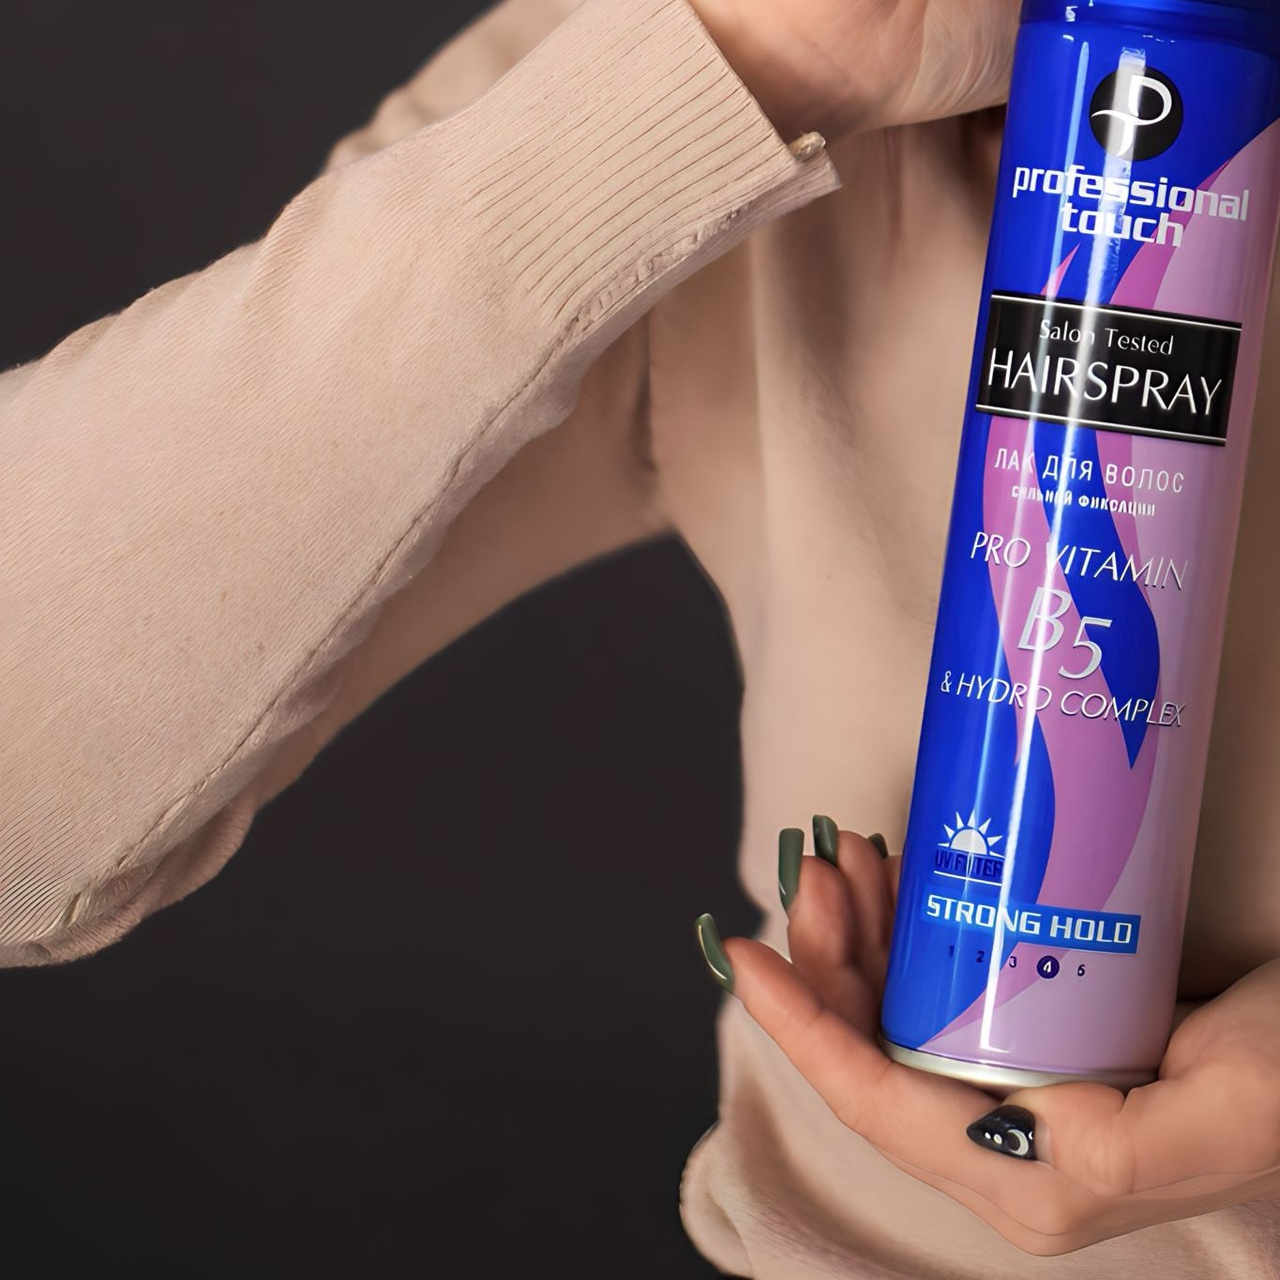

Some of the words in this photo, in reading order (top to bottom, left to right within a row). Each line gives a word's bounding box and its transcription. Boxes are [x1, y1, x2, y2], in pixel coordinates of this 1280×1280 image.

[1013, 165, 1249, 221] professional
[1061, 202, 1184, 247] touch
[1039, 319, 1096, 347] Salon
[1104, 327, 1174, 356] Tested
[987, 347, 1223, 416] HAIRSPRAY
[994, 448, 1034, 475] ЛАК
[1042, 454, 1093, 482] ДЛЯ
[1105, 463, 1185, 494] ВОЛОС
[971, 531, 1031, 569] PRO
[1046, 541, 1189, 590] VITAMIN
[1017, 586, 1113, 680] B5
[956, 672, 1053, 710] HYDRO
[1060, 690, 1186, 728] COMPLEX
[927, 894, 1041, 935] STRONG
[1049, 915, 1132, 944] HOLD
[976, 950, 985, 963] 2
